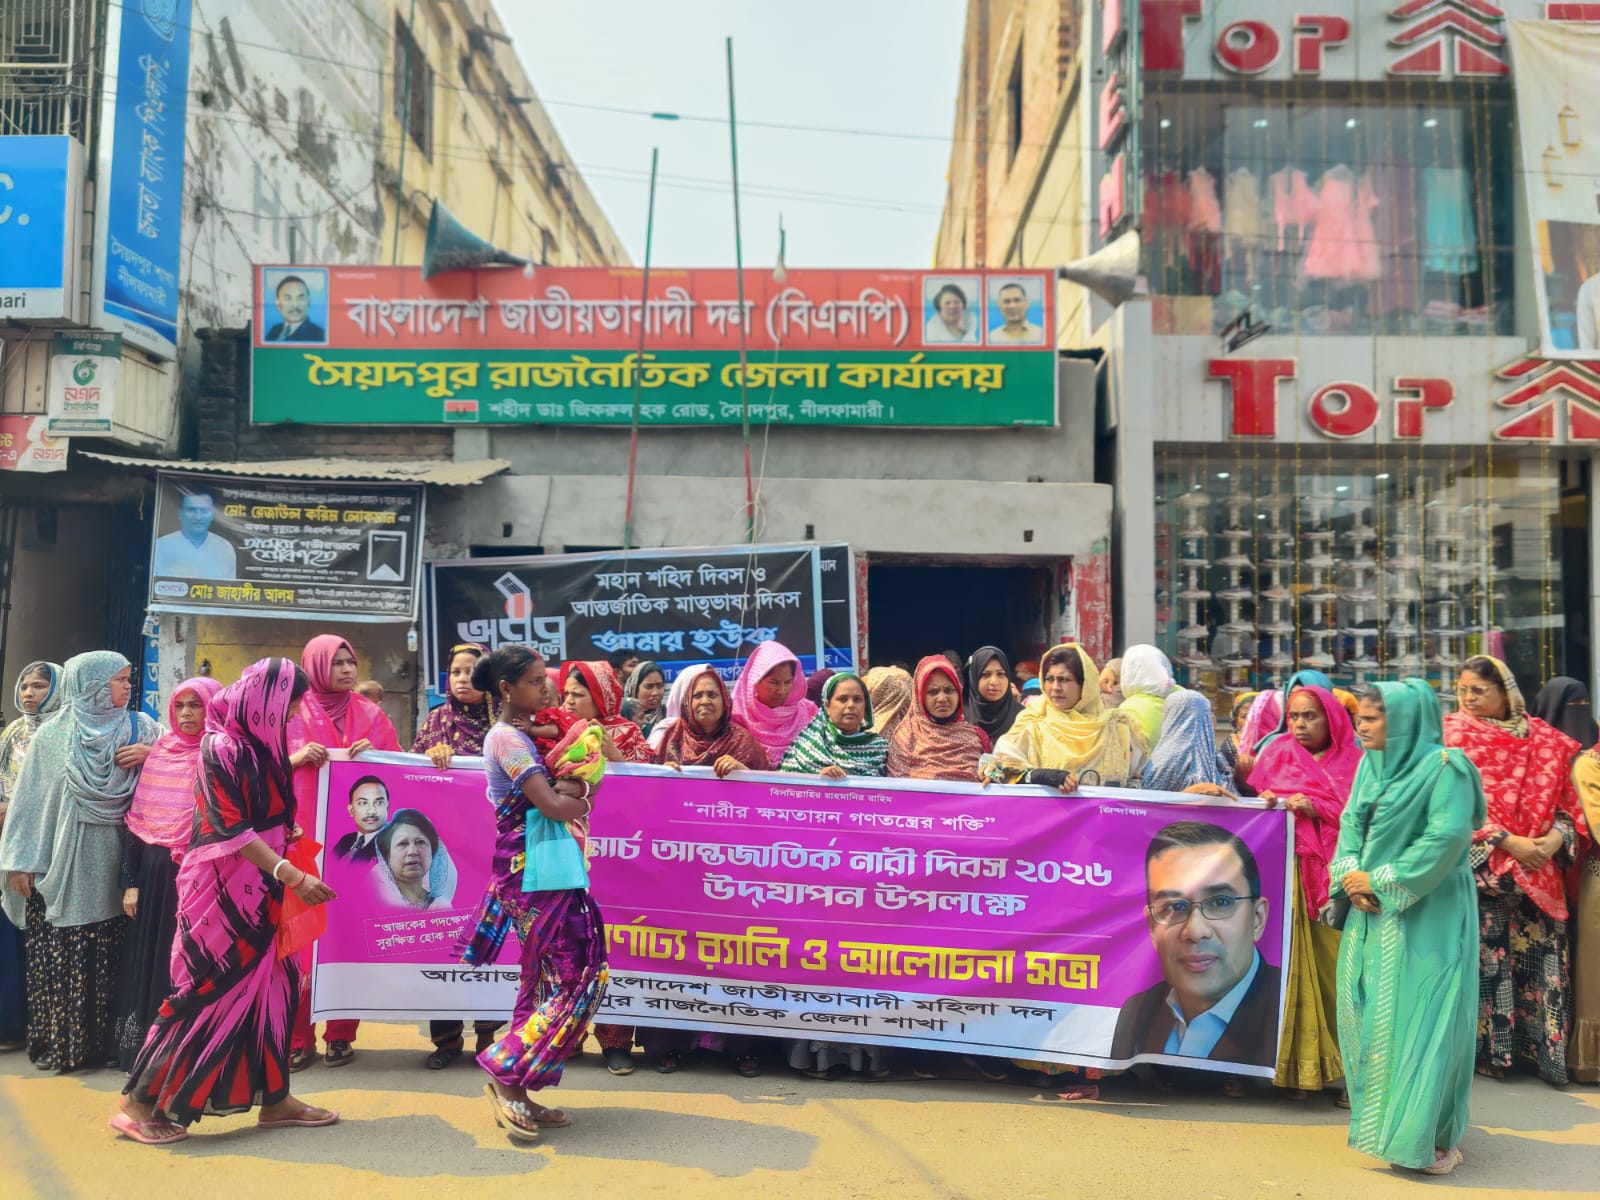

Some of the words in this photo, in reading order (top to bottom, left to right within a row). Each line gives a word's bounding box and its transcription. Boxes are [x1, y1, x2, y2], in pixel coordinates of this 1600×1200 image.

[346, 294, 489, 337] বাংলাদেশ
[497, 285, 696, 338] জাতীয়তাবাদী
[704, 298, 754, 336] দল
[766, 287, 910, 345] (বিএনপি)
[303, 352, 480, 398] সৈয়দপুর
[487, 353, 711, 390] রাজনৈতিক
[721, 358, 829, 391] জেলা
[837, 352, 1005, 393] কার্যালয়
[1207, 356, 1457, 441] TOP
[595, 572, 643, 590] মহান
[647, 564, 695, 589] শহিদ
[698, 563, 745, 587] দিবস
[750, 567, 767, 582] ও
[571, 592, 672, 618] আন্তর্জাতিক
[674, 593, 750, 619] মাতৃভাষা
[755, 587, 802, 609] দিবস
[755, 806, 843, 826] ক্ষমতায়ন
[849, 811, 935, 831] গণতন্ত্রের
[849, 846, 918, 878] নারী
[923, 849, 1010, 880] দিবস
[1014, 858, 1113, 888] ২০২৬
[873, 881, 1030, 918] উপলক্ষে
[603, 914, 688, 961] র্ণাঢ্য
[800, 939, 828, 971] ও
[837, 940, 1016, 985] আলোচনা
[1024, 950, 1101, 991] সভা
[420, 968, 521, 984] আয়োজ
[608, 974, 711, 995] ংলাদেশ
[720, 983, 905, 1012] জাতীয়তাবাদী
[910, 998, 1001, 1017] মহিলা
[1008, 1003, 1059, 1022] দল
[642, 997, 789, 1021] রাজনৈতিক
[799, 1010, 872, 1027] জেলা
[880, 1014, 950, 1032] শাখা
